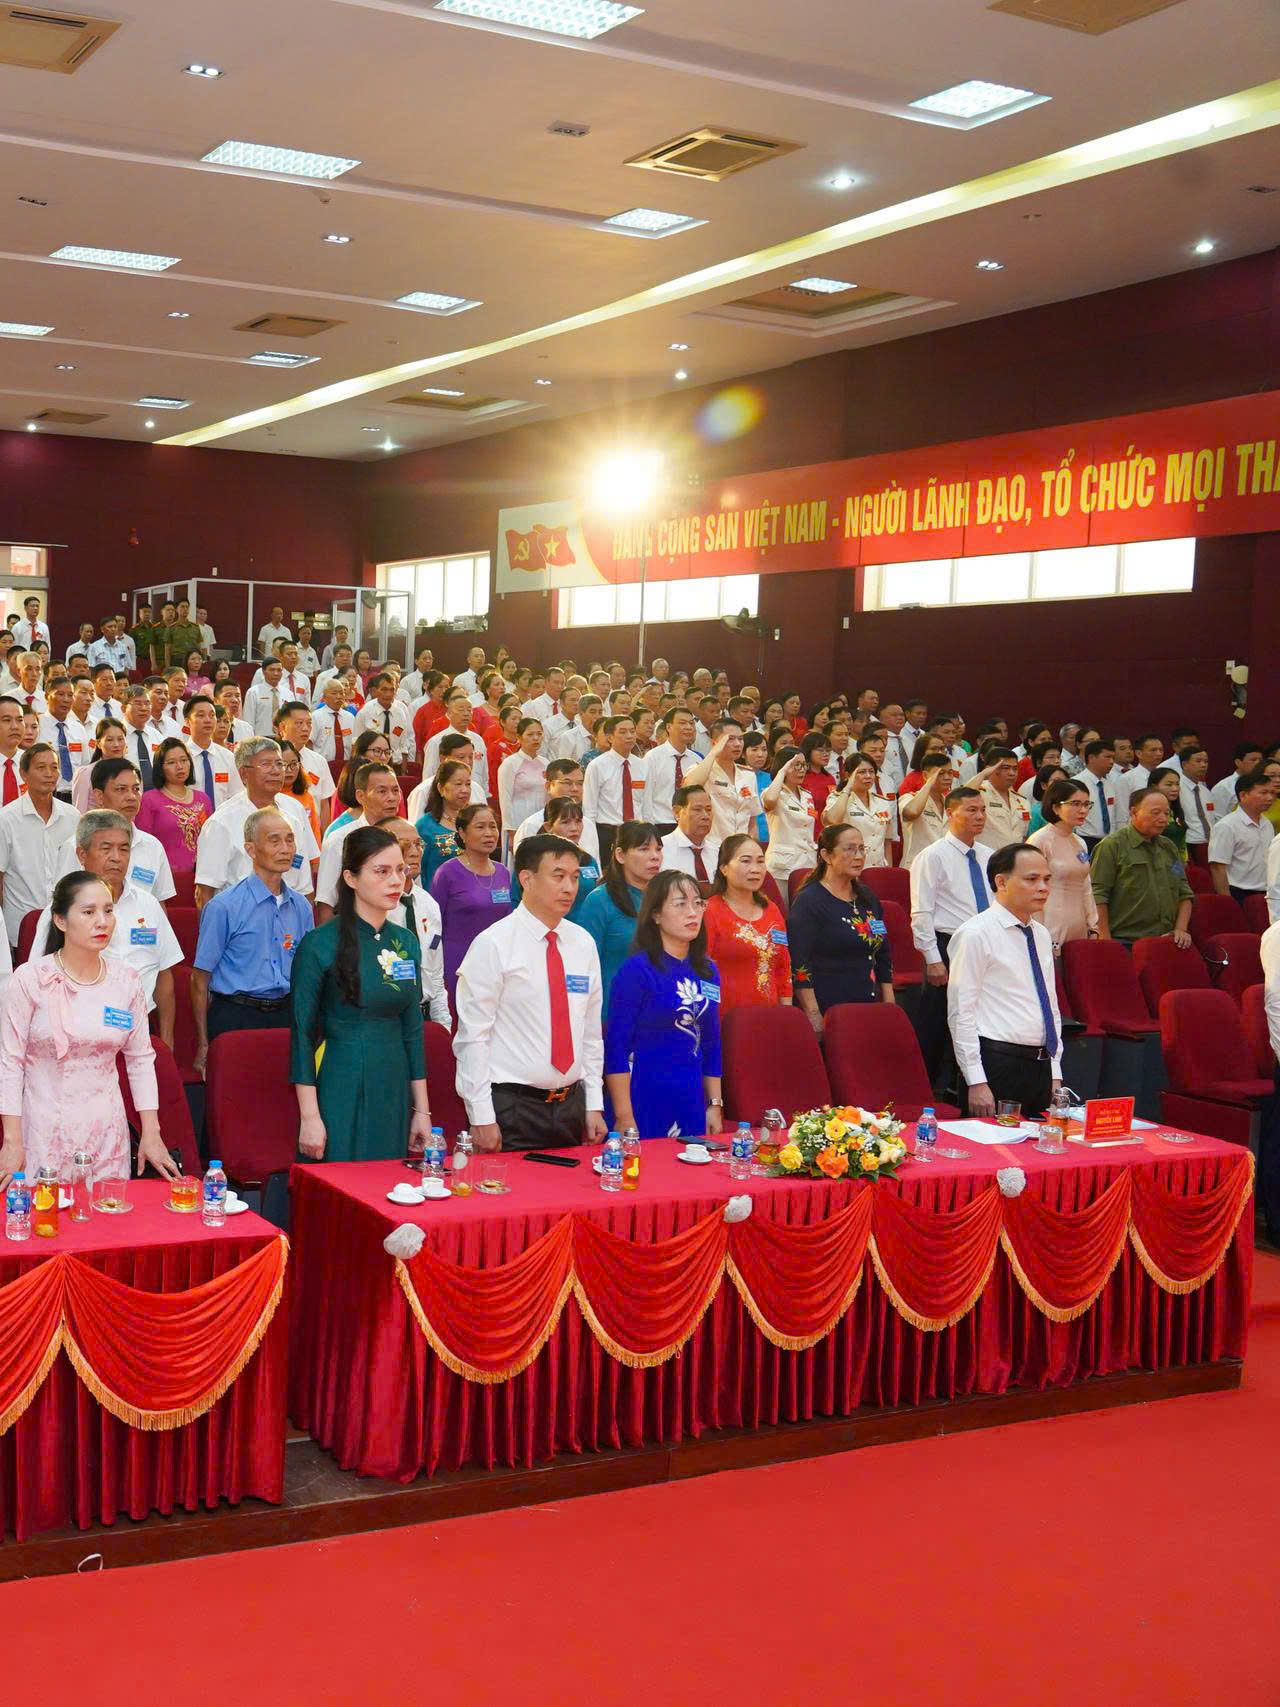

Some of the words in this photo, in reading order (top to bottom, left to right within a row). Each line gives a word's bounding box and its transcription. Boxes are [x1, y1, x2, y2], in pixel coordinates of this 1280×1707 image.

[744, 498, 780, 556] VIỆT
[783, 500, 828, 545] NAM
[845, 480, 907, 538] NGƯỜI
[912, 476, 970, 532] LÃNH
[976, 474, 1032, 534] ĐẠO,
[1041, 448, 1075, 518] TỔ
[1080, 445, 1156, 515] CHỨC
[1163, 447, 1225, 513] MỌI
[1236, 440, 1280, 496] TH
